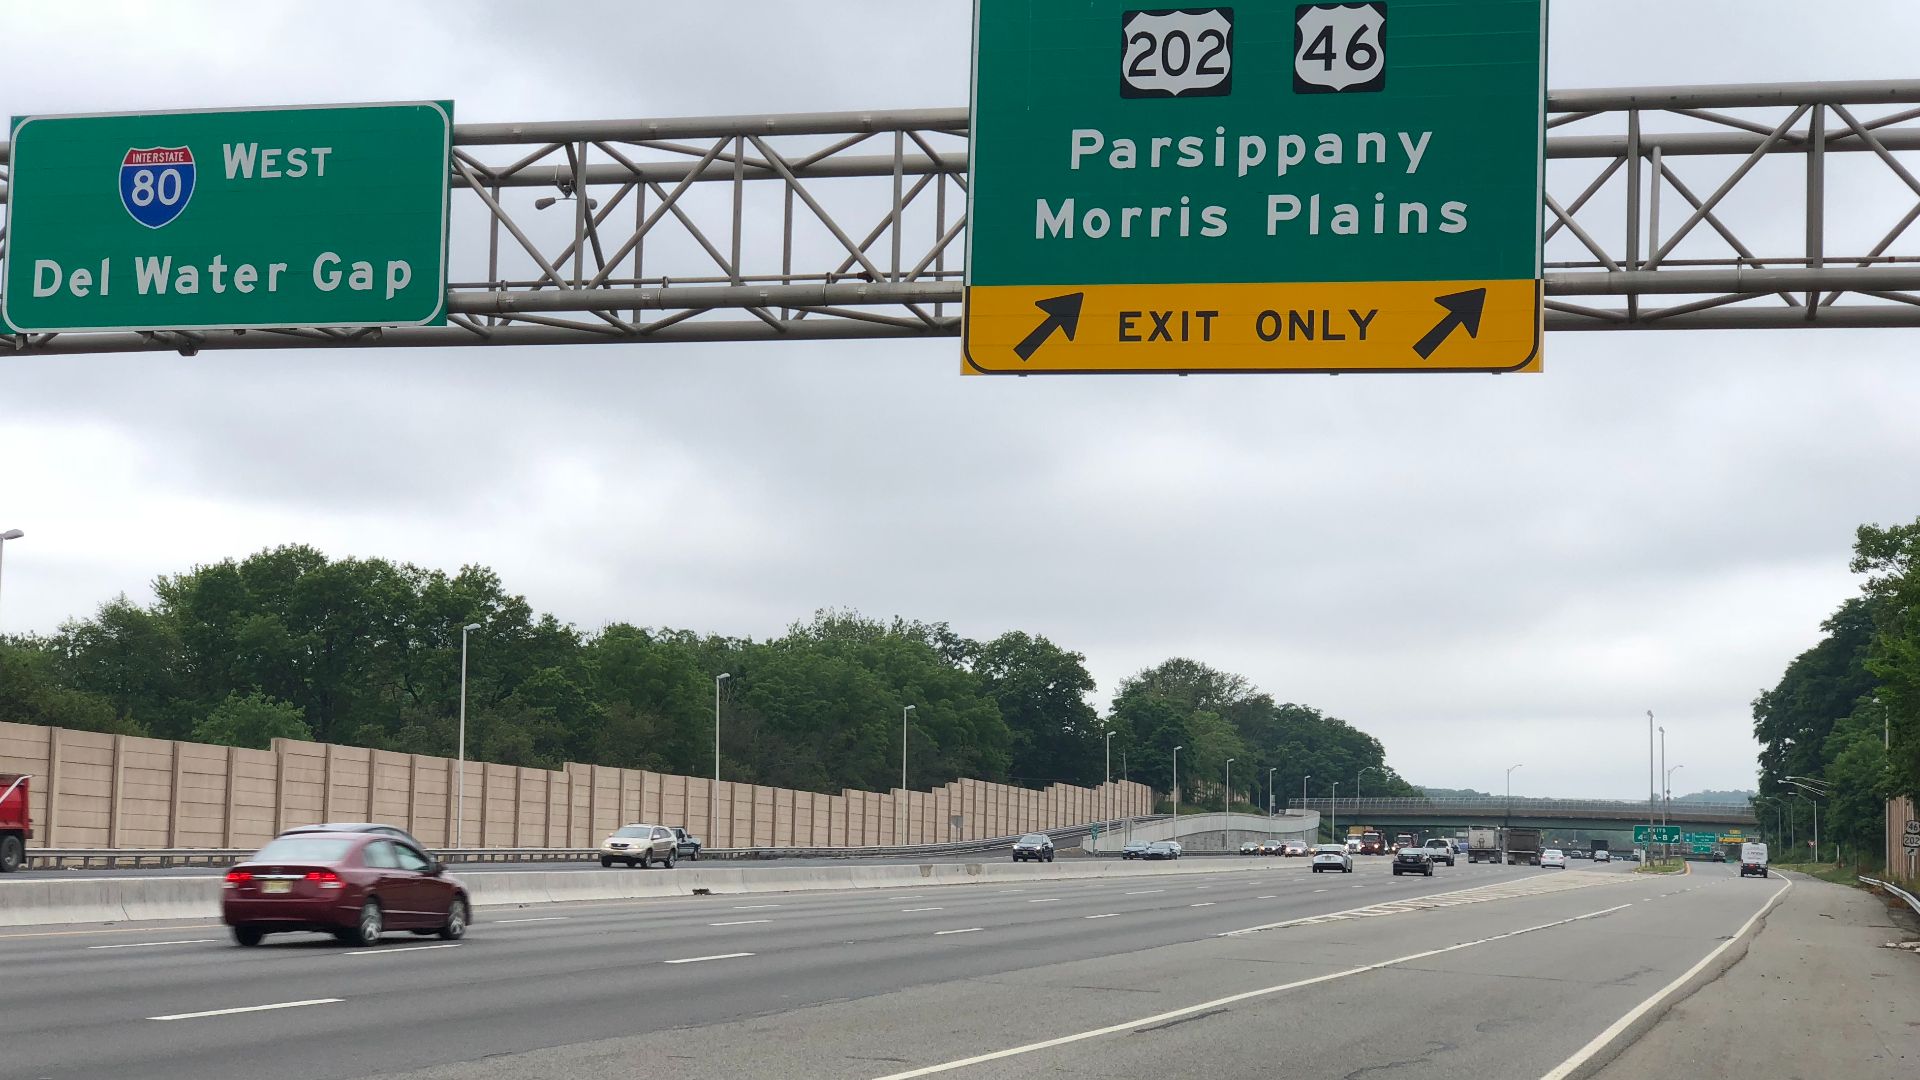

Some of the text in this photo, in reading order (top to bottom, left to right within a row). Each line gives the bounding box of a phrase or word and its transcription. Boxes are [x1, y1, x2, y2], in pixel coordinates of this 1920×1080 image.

[1128, 24, 1377, 77] 202 46
[132, 152, 185, 163] INTERSTATE
[1071, 127, 1432, 177] Parsippany
[131, 168, 182, 207] 80
[1036, 193, 1468, 239] Morris Plains
[33, 251, 412, 300] Del Water Gap
[1119, 309, 1378, 342] EXIT ONLY
[1909, 822, 1918, 831] 46
